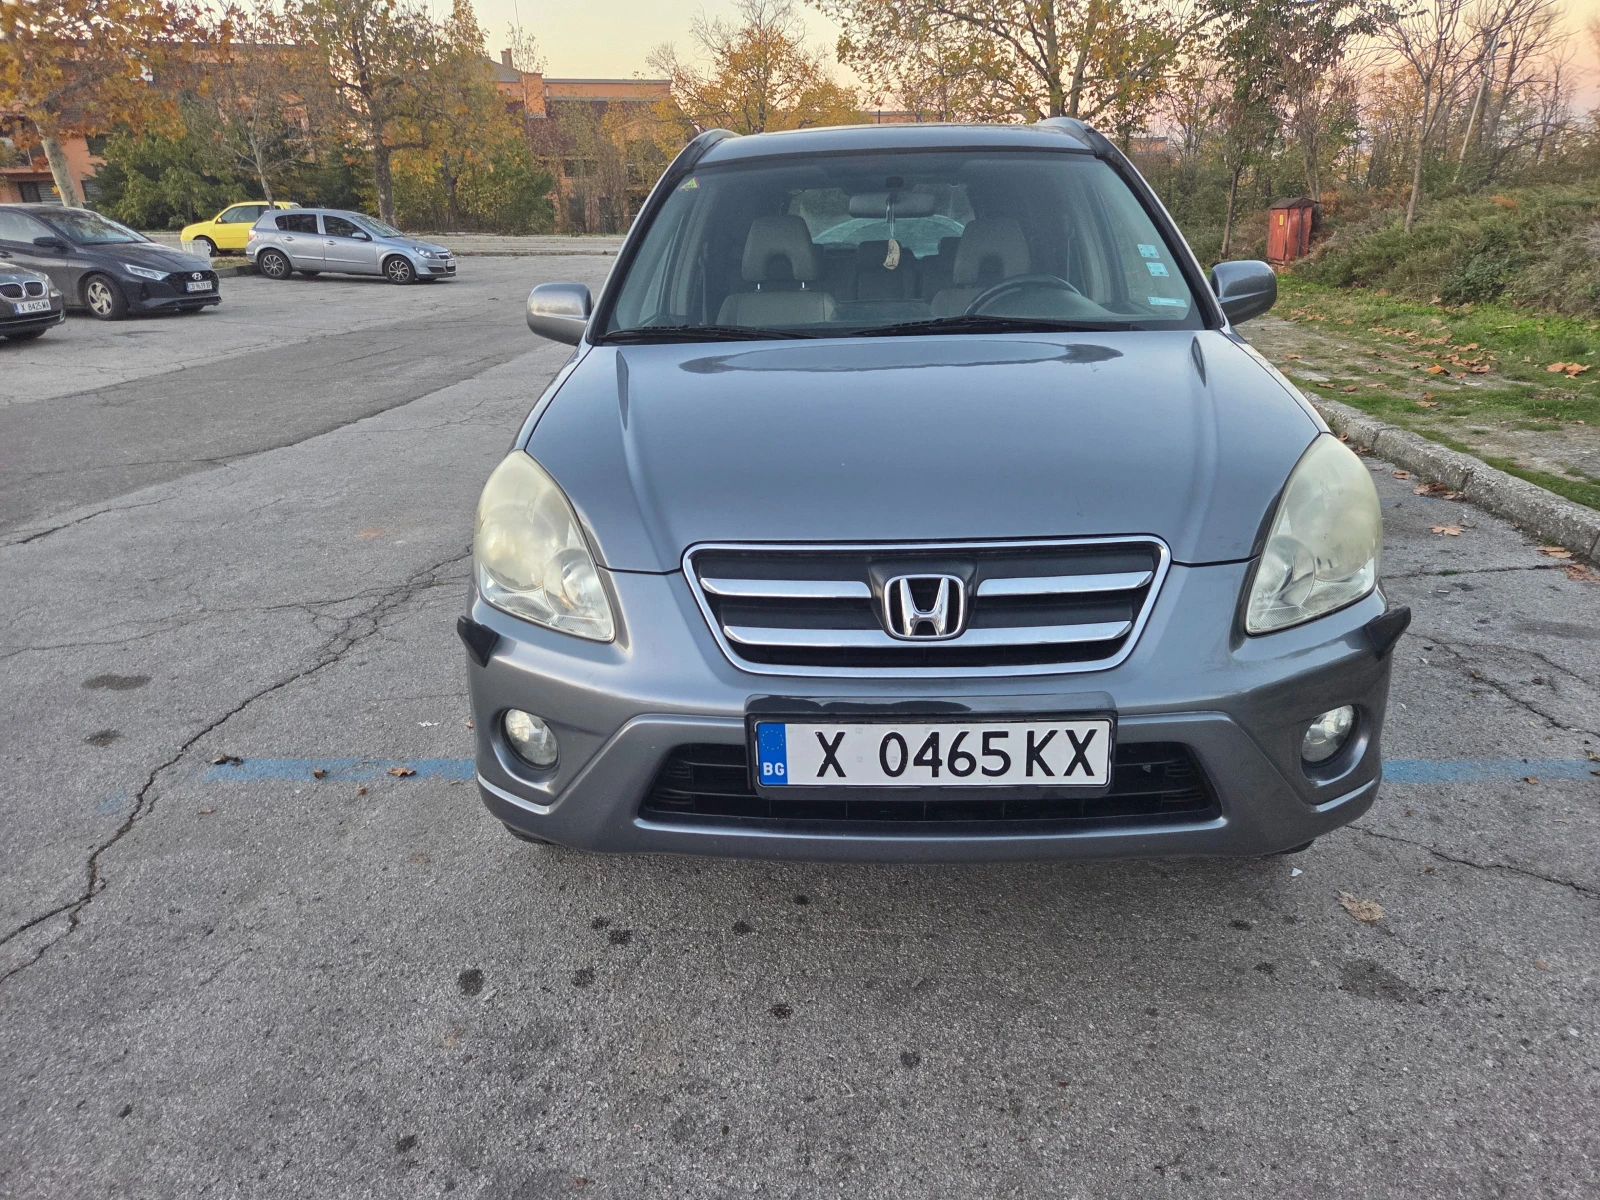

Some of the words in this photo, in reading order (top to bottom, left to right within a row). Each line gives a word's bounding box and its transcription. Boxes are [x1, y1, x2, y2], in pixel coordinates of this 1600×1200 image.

[20, 303, 26, 312] X
[815, 731, 847, 777] X
[763, 762, 785, 776] BG
